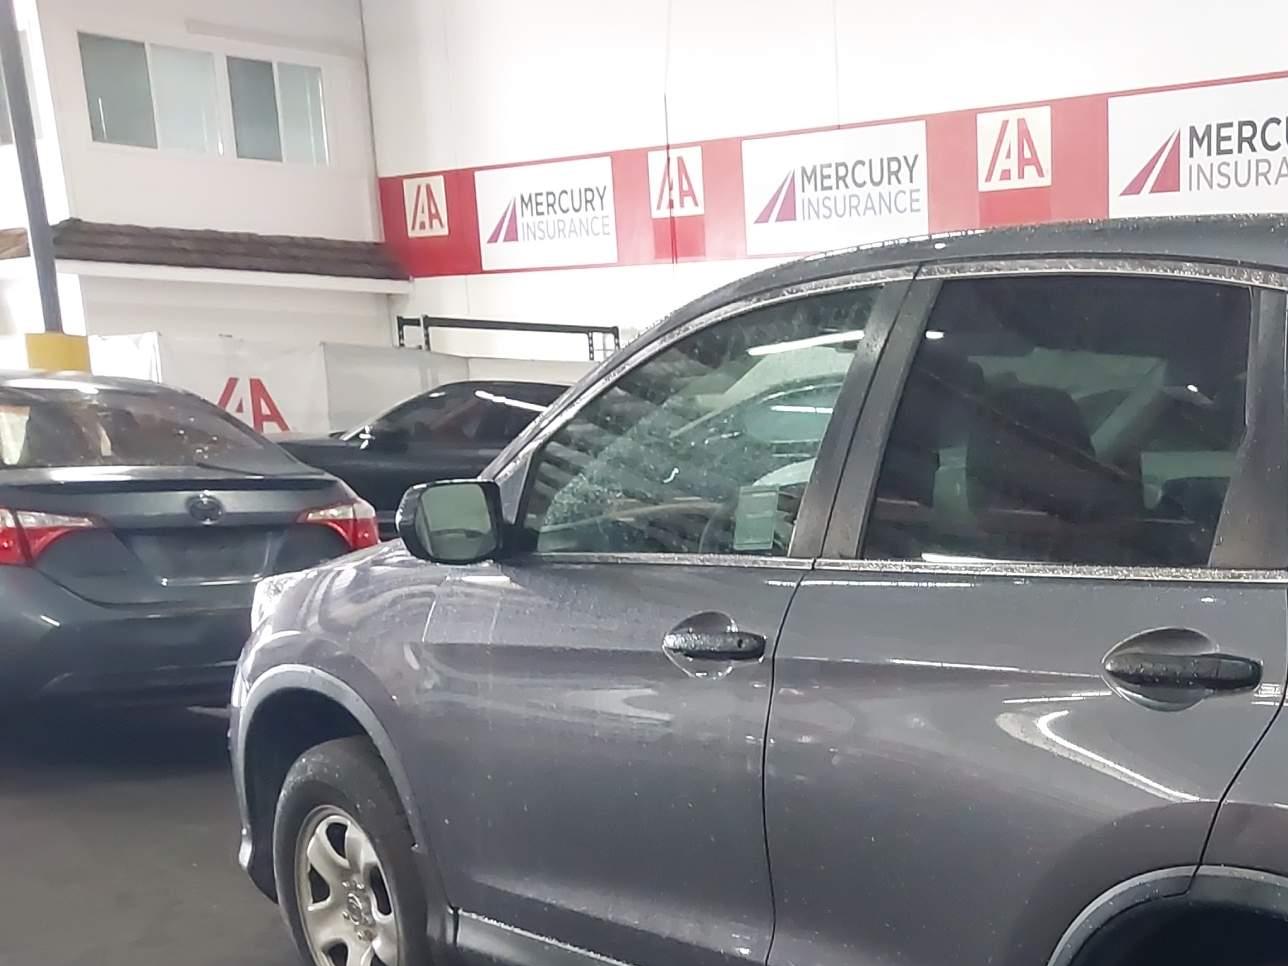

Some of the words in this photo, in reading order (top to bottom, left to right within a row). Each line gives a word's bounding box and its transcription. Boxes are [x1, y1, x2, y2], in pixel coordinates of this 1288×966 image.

[800, 155, 920, 192] MERCURY
[520, 186, 608, 217] MERCURY
[801, 190, 921, 222] INSURANCE
[520, 214, 611, 242] INSURANCE
